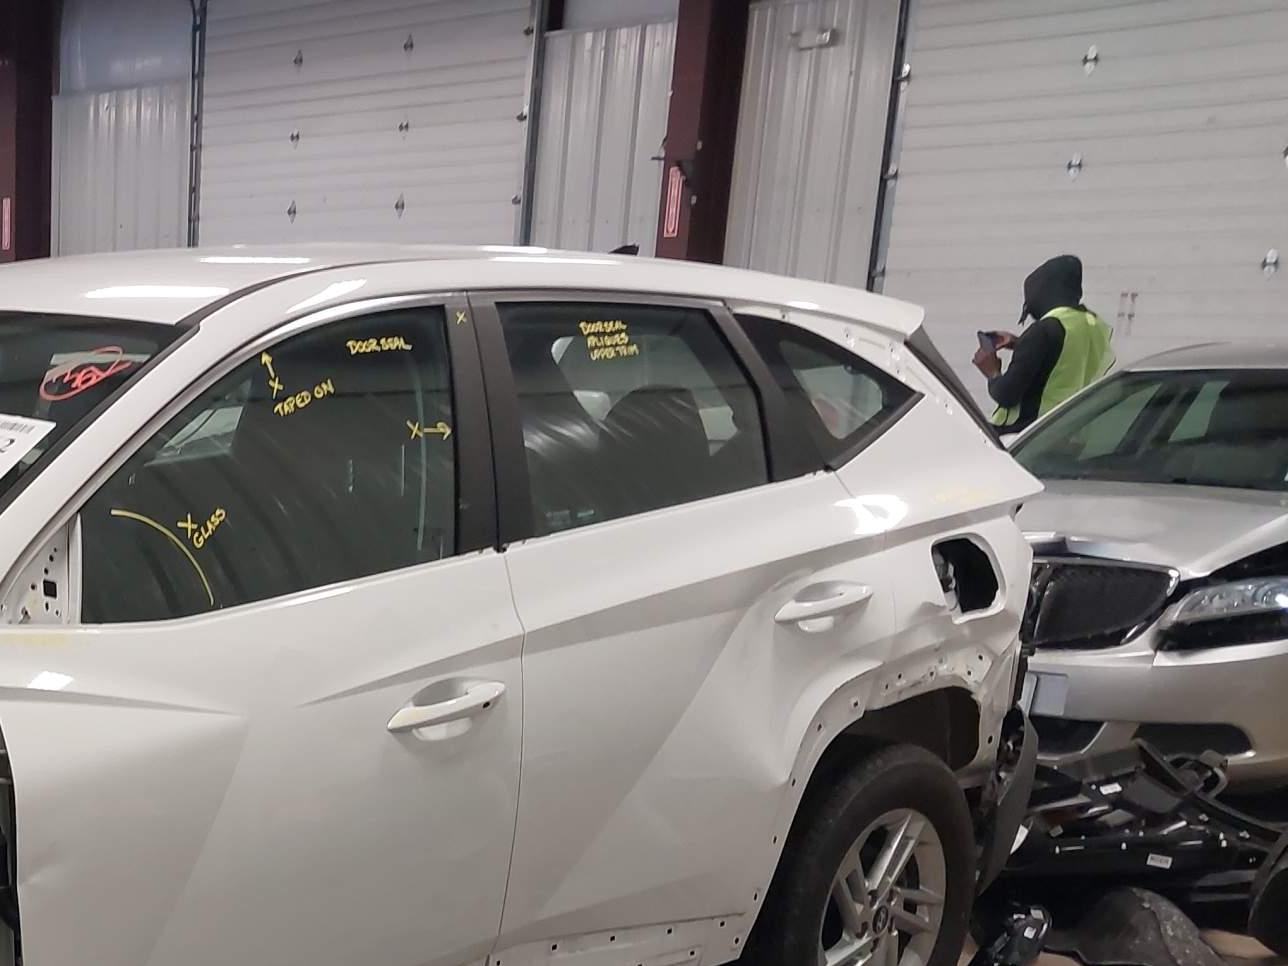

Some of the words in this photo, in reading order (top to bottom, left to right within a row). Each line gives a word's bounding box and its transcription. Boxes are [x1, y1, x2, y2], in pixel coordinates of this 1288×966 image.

[346, 340, 380, 355] DOOR
[379, 336, 412, 351] SEAL
[273, 390, 312, 417] TAPED
[314, 378, 335, 399] ON
[193, 508, 226, 549] GLASS
